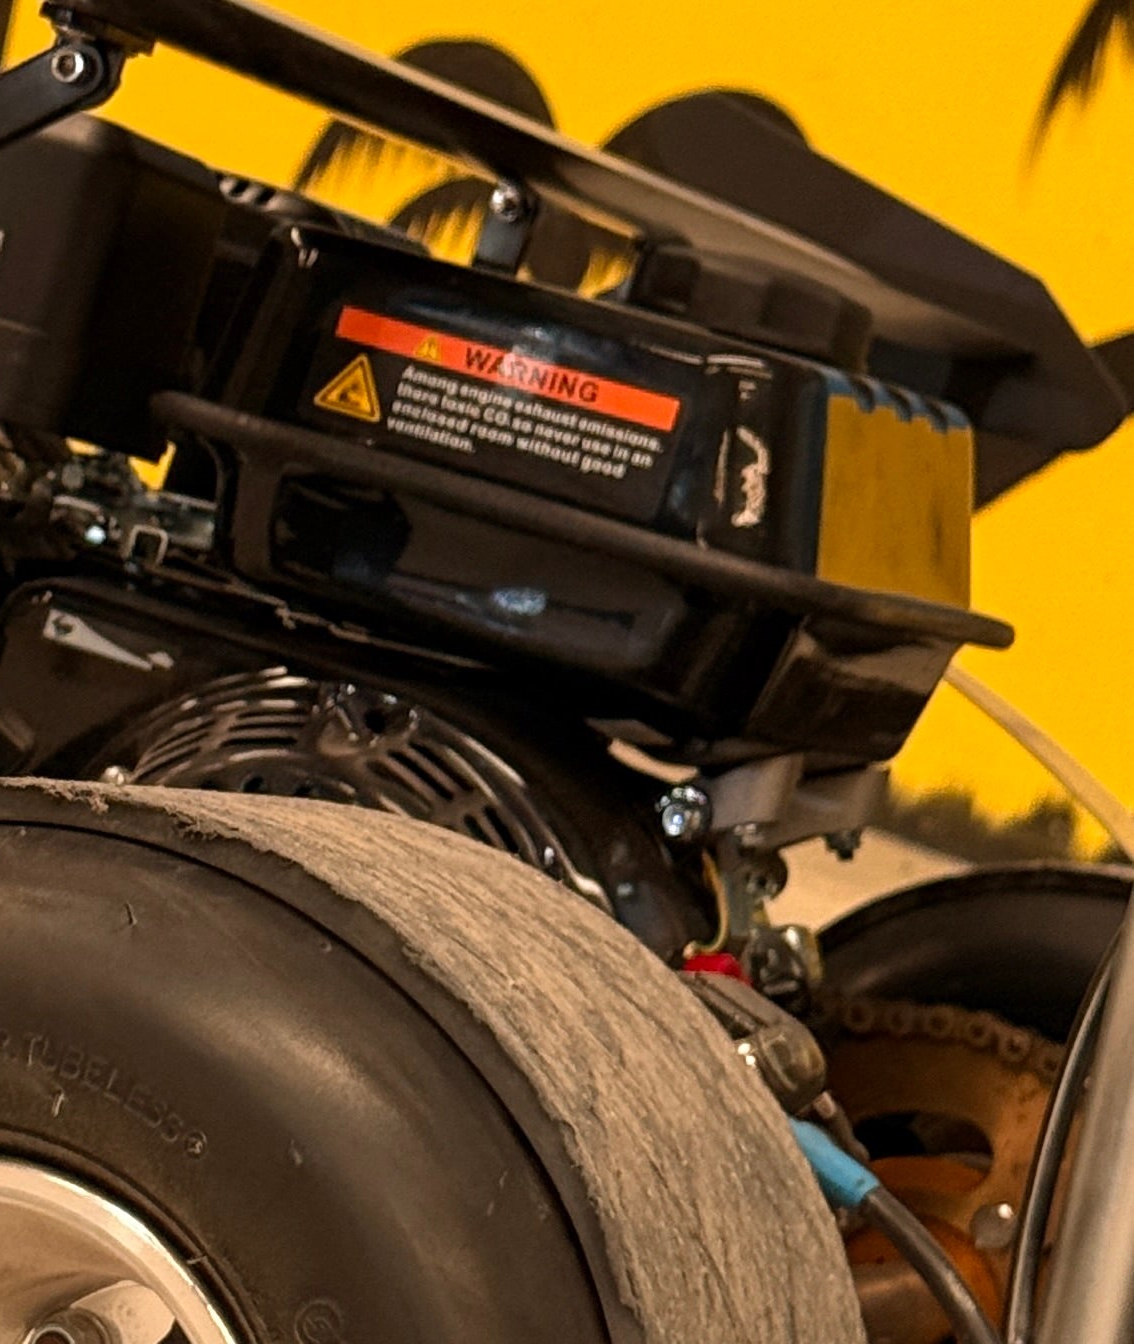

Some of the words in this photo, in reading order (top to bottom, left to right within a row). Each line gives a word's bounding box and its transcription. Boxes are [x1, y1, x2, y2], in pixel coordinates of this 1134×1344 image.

[402, 364, 458, 395] Among
[460, 385, 512, 408] engine
[514, 400, 579, 429] exhaust
[466, 346, 599, 403] WARNING
[392, 399, 470, 433] enclosed
[469, 422, 514, 446] room
[516, 437, 580, 467] without
[580, 455, 627, 479] good
[397, 382, 439, 405] there
[534, 424, 580, 447] never
[582, 437, 611, 455] use
[613, 444, 630, 462] in
[631, 452, 653, 468] an
[24, 1033, 186, 1143] TUBELESS
